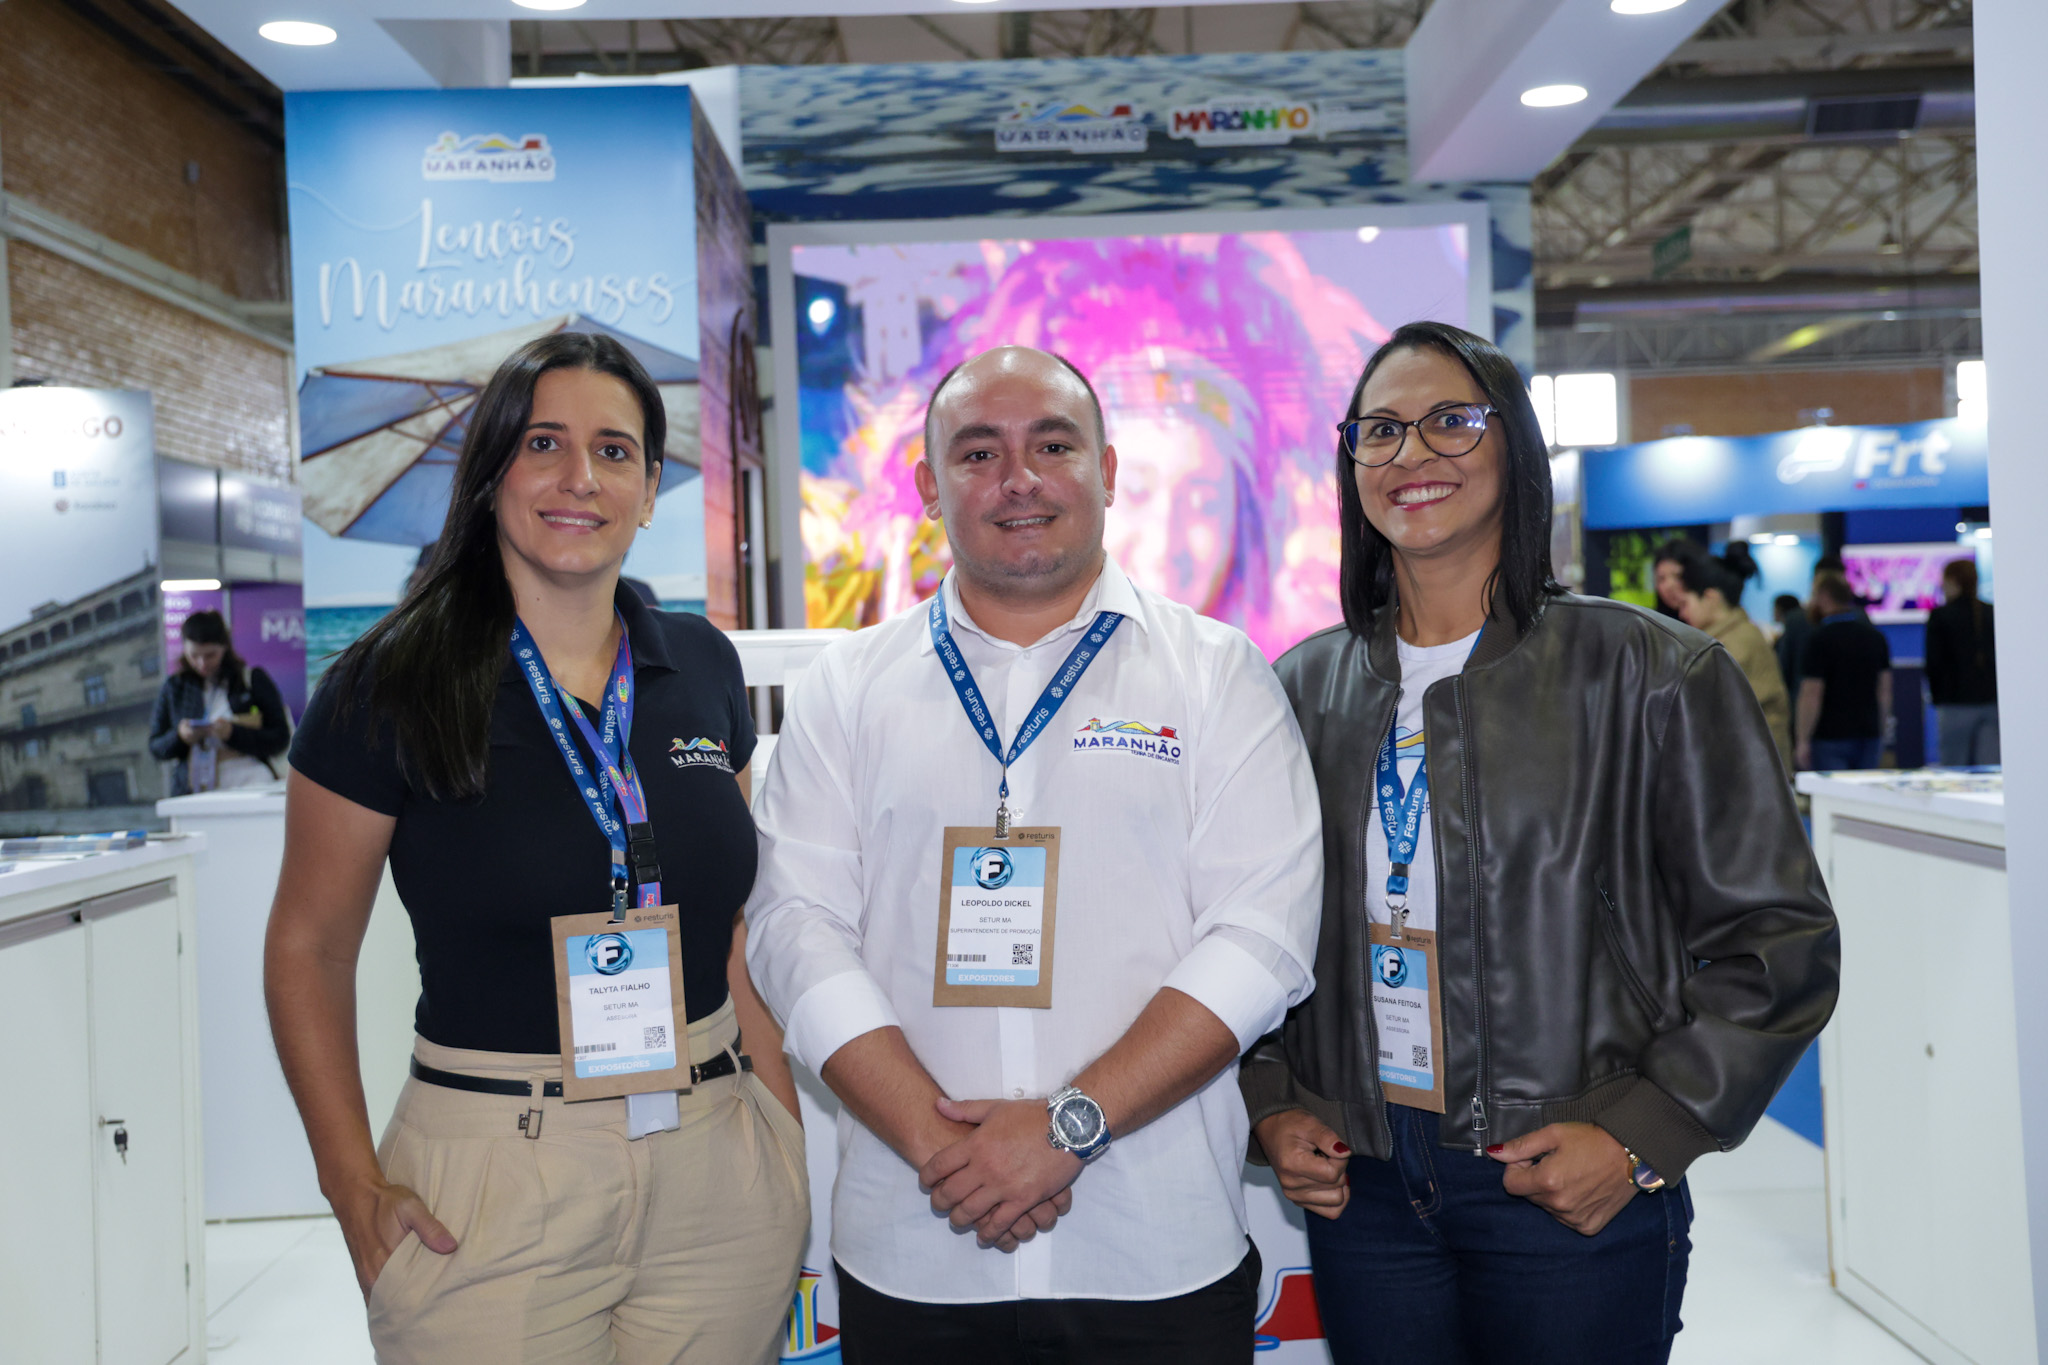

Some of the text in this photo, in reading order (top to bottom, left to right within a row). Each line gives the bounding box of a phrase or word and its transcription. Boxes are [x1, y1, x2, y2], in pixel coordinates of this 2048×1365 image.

[417, 198, 577, 270] Lençóis
[319, 254, 675, 330] Maranhenses
[938, 632, 960, 670] Festuris
[1060, 650, 1091, 687] Festuris
[526, 660, 551, 705] Festuris
[965, 687, 987, 727] Festuris
[1016, 707, 1049, 749] Festuris
[556, 732, 584, 776] Festuris
[1073, 736, 1181, 758] MARANHÃO
[1404, 787, 1423, 838] Festuris
[643, 912, 674, 922] Festuris
[588, 982, 650, 995] TALYTA FIALHO
[958, 974, 1015, 982] EXPOSITORES
[603, 1001, 639, 1011] SETUR MA
[1373, 995, 1422, 1009] SUSANA FEITOSA
[1385, 1014, 1401, 1023] SETUR
[588, 1060, 651, 1074] EXPOSITORES
